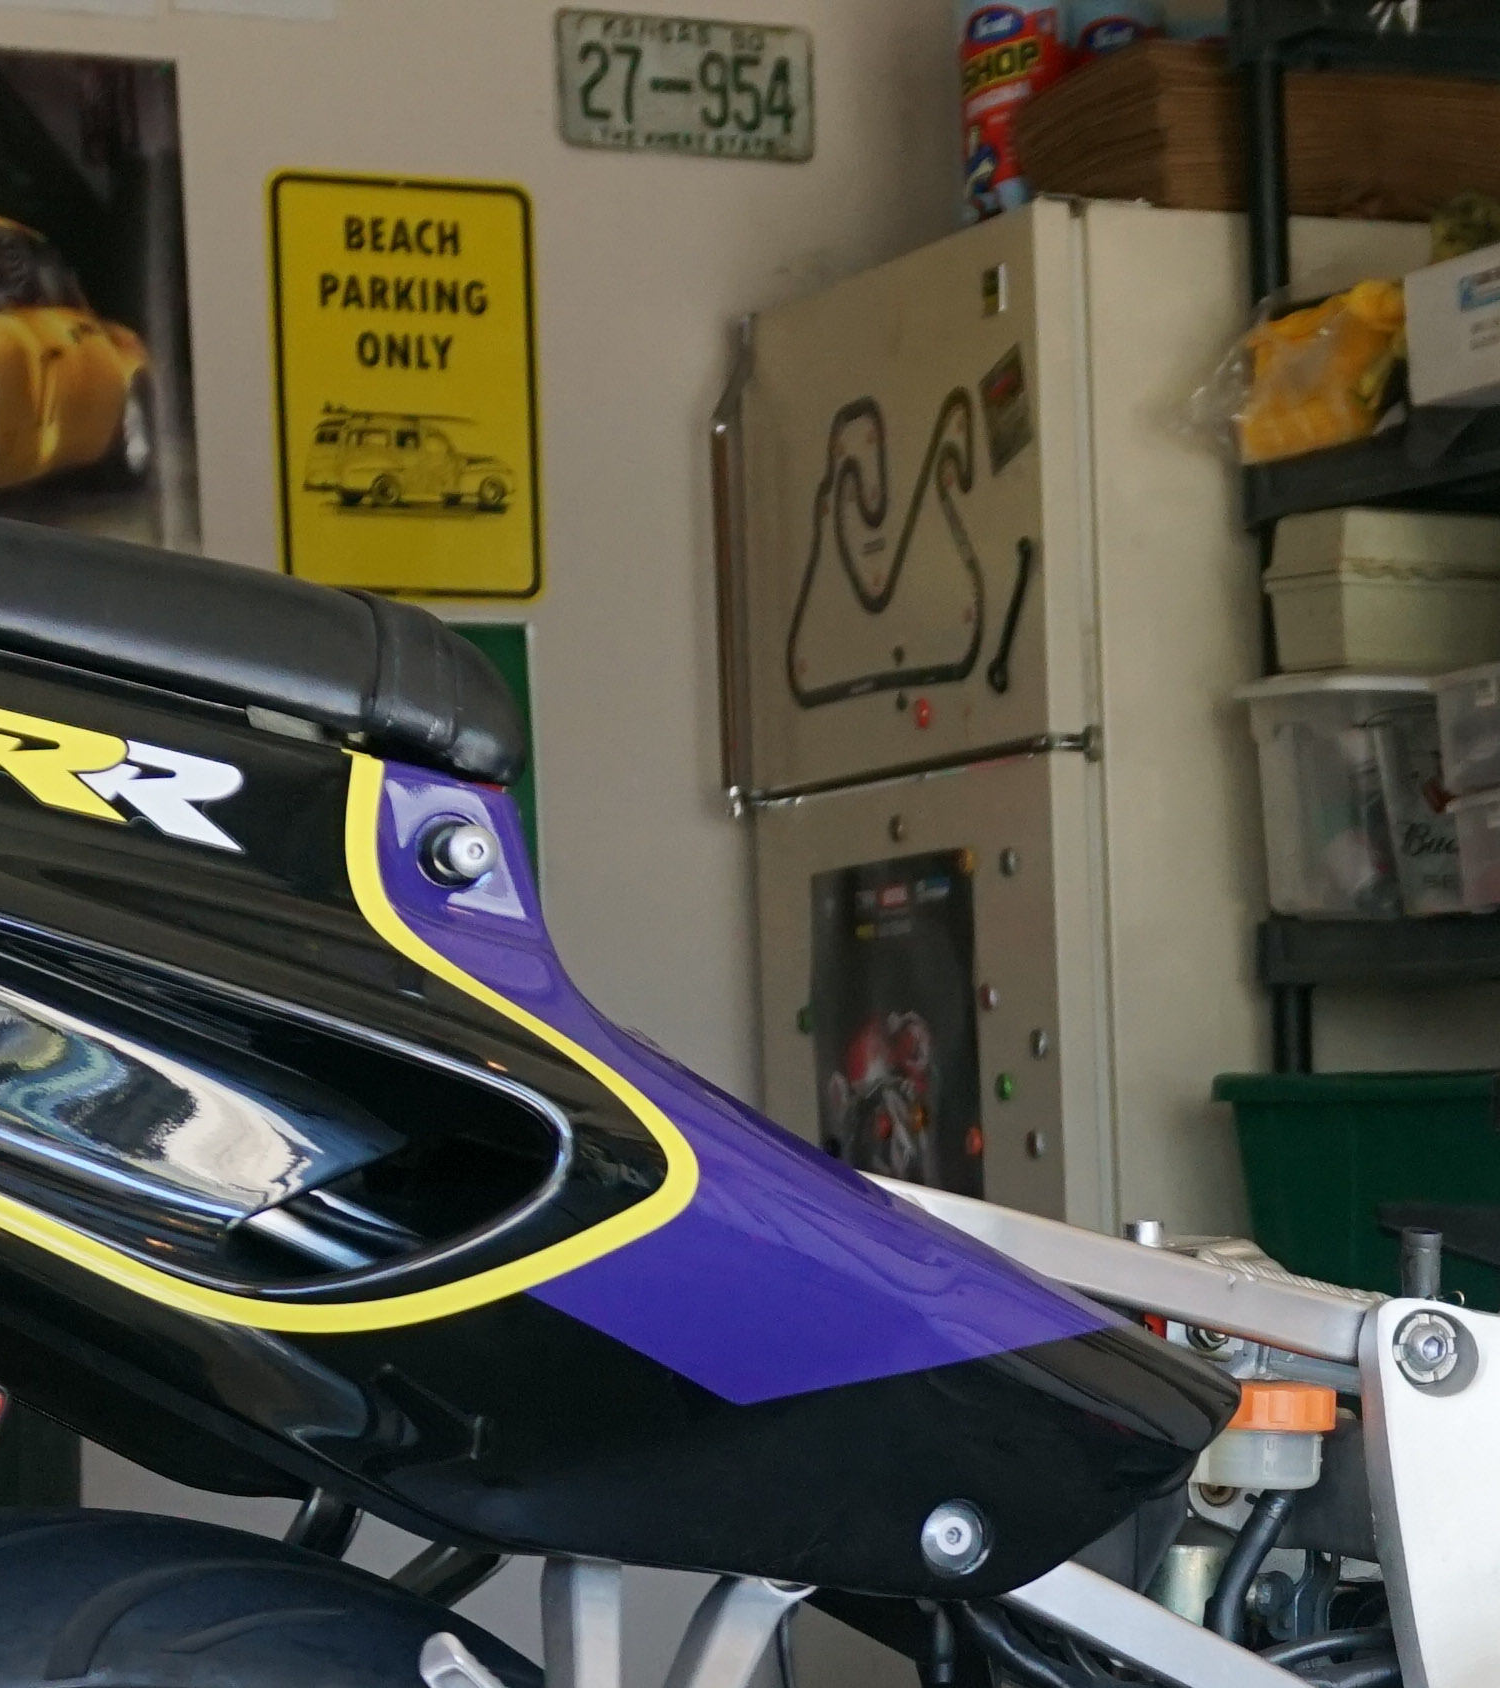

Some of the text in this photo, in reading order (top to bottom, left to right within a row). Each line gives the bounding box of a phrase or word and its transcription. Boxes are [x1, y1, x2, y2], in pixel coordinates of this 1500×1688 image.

[577, 40, 796, 135] 27-954
[343, 216, 461, 257] BEACH
[318, 273, 488, 316] PARKING
[356, 332, 454, 372] ONLY
